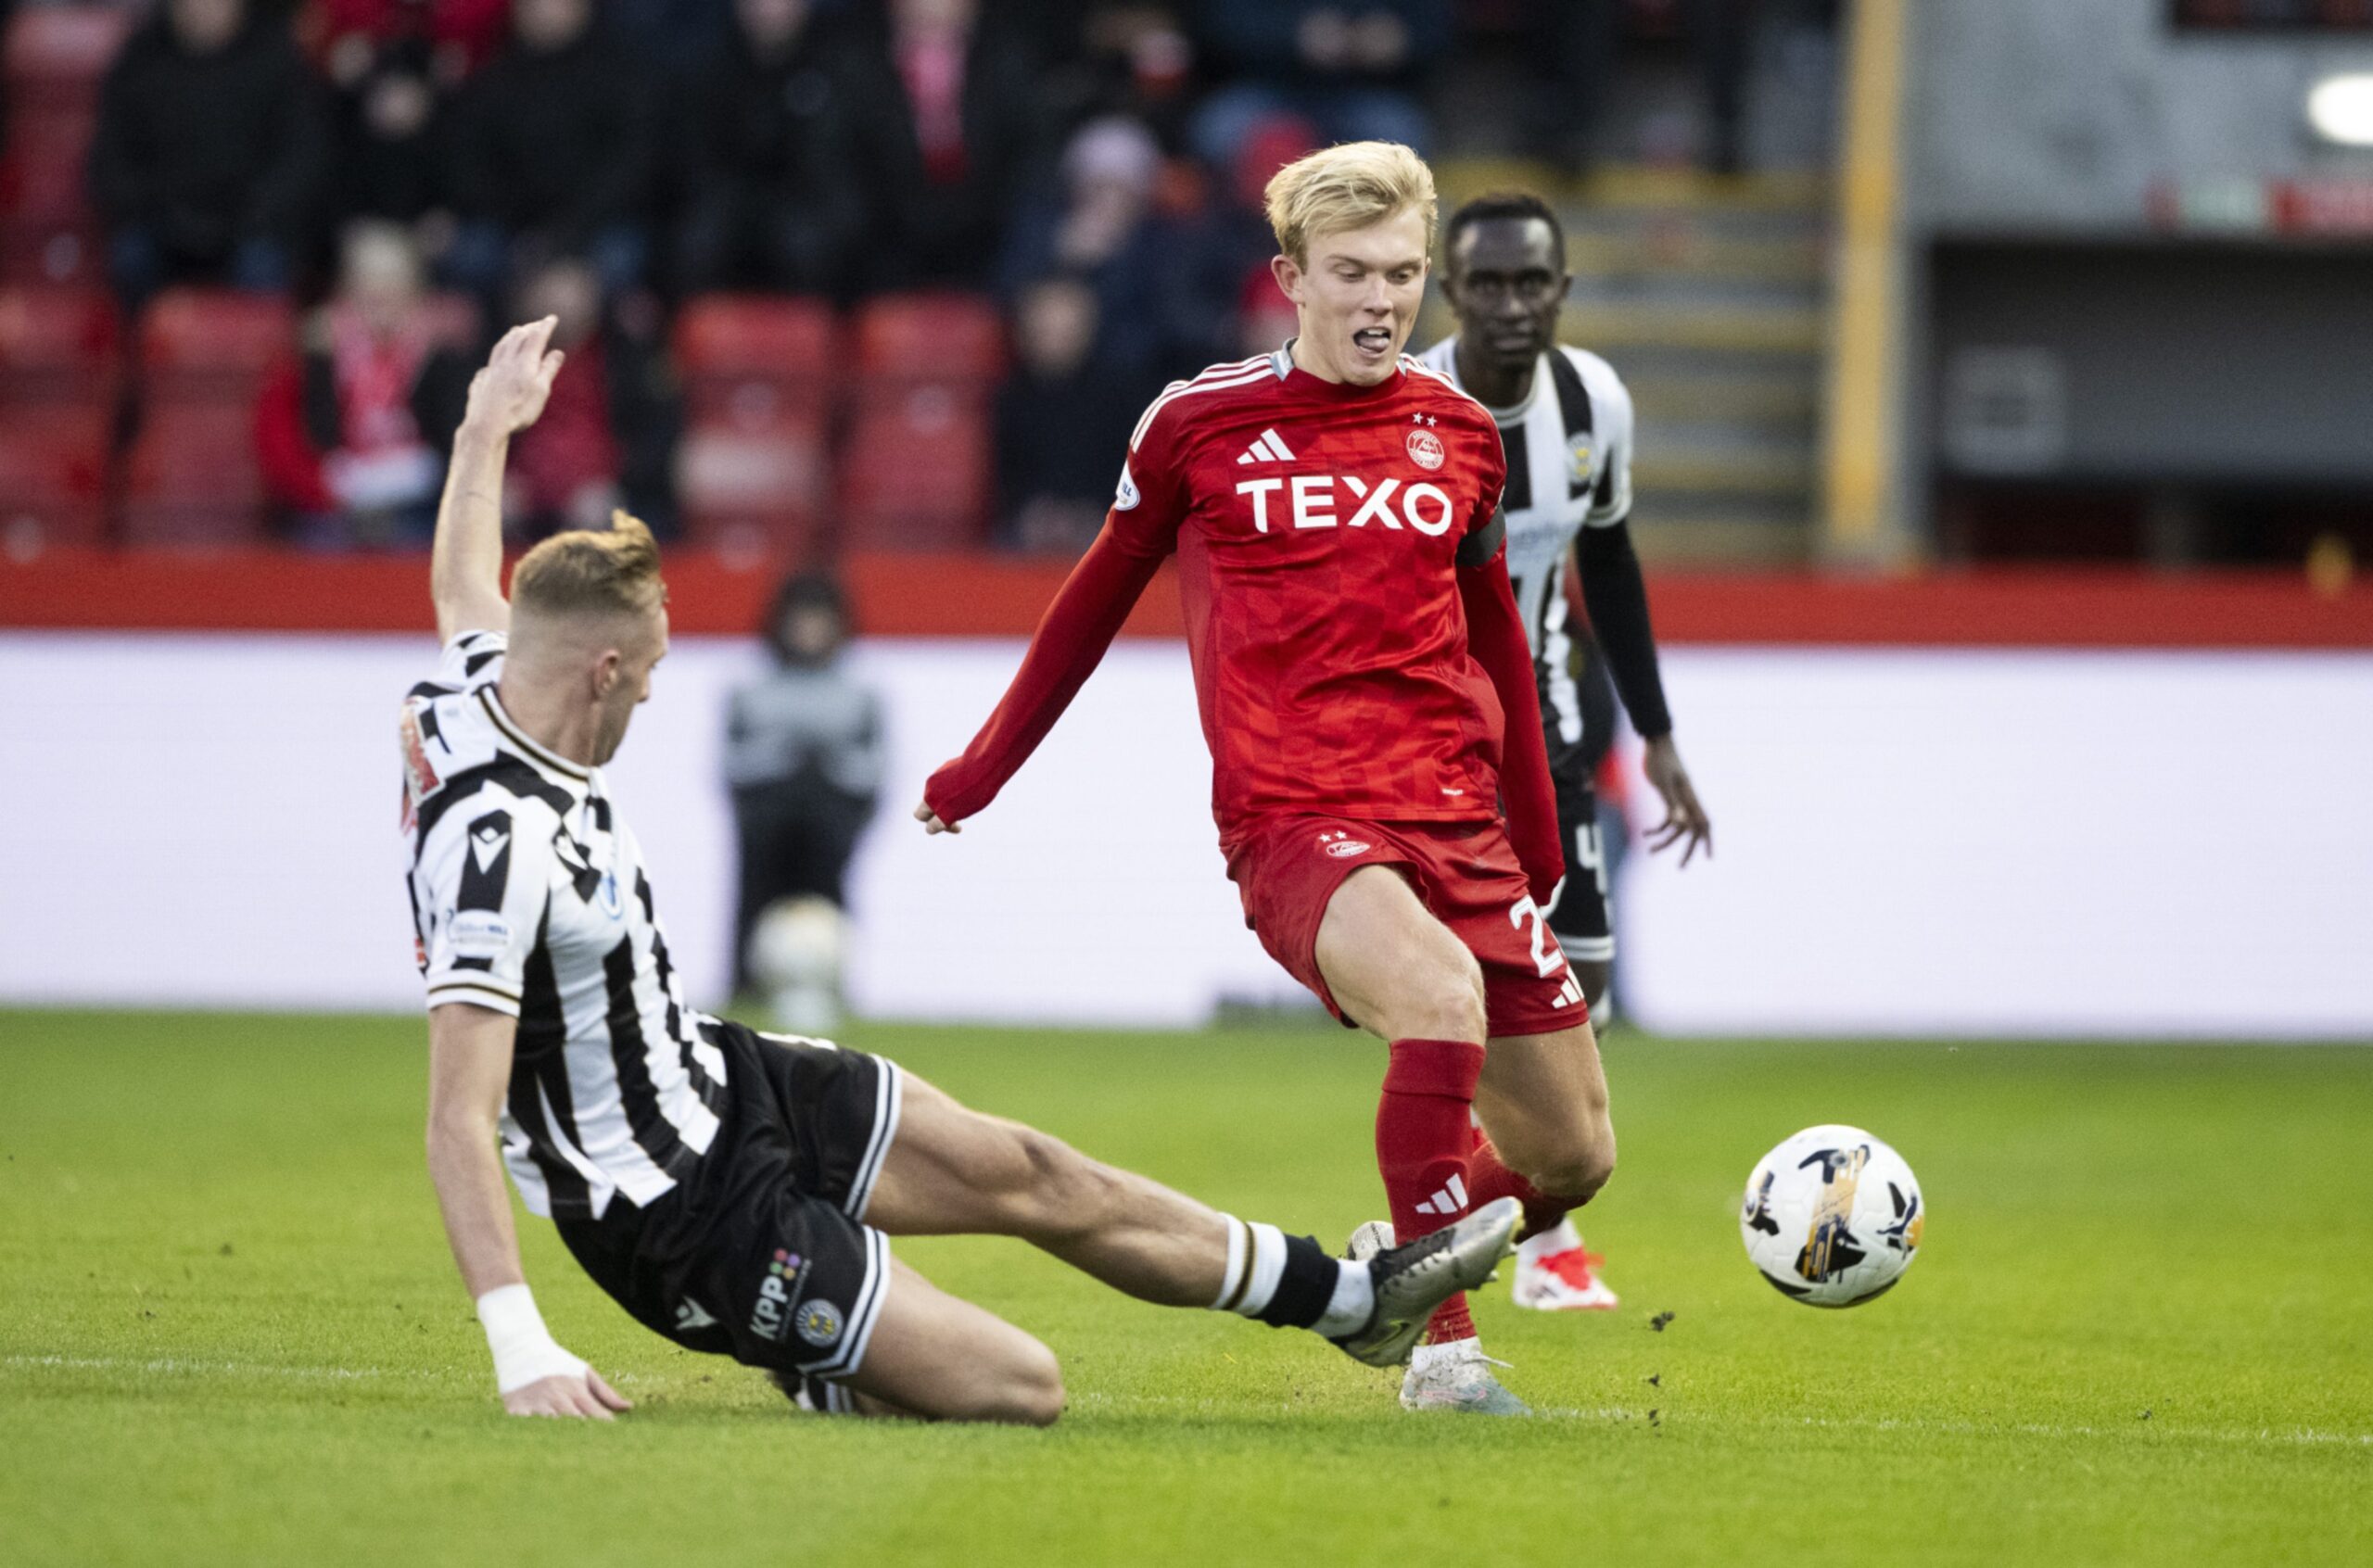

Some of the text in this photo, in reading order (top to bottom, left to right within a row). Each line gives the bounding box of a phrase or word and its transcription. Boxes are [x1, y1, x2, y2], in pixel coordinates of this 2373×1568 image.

[1236, 475, 1453, 537] TEXO
[1576, 824, 1607, 894] 4
[749, 1275, 788, 1341] KPP
